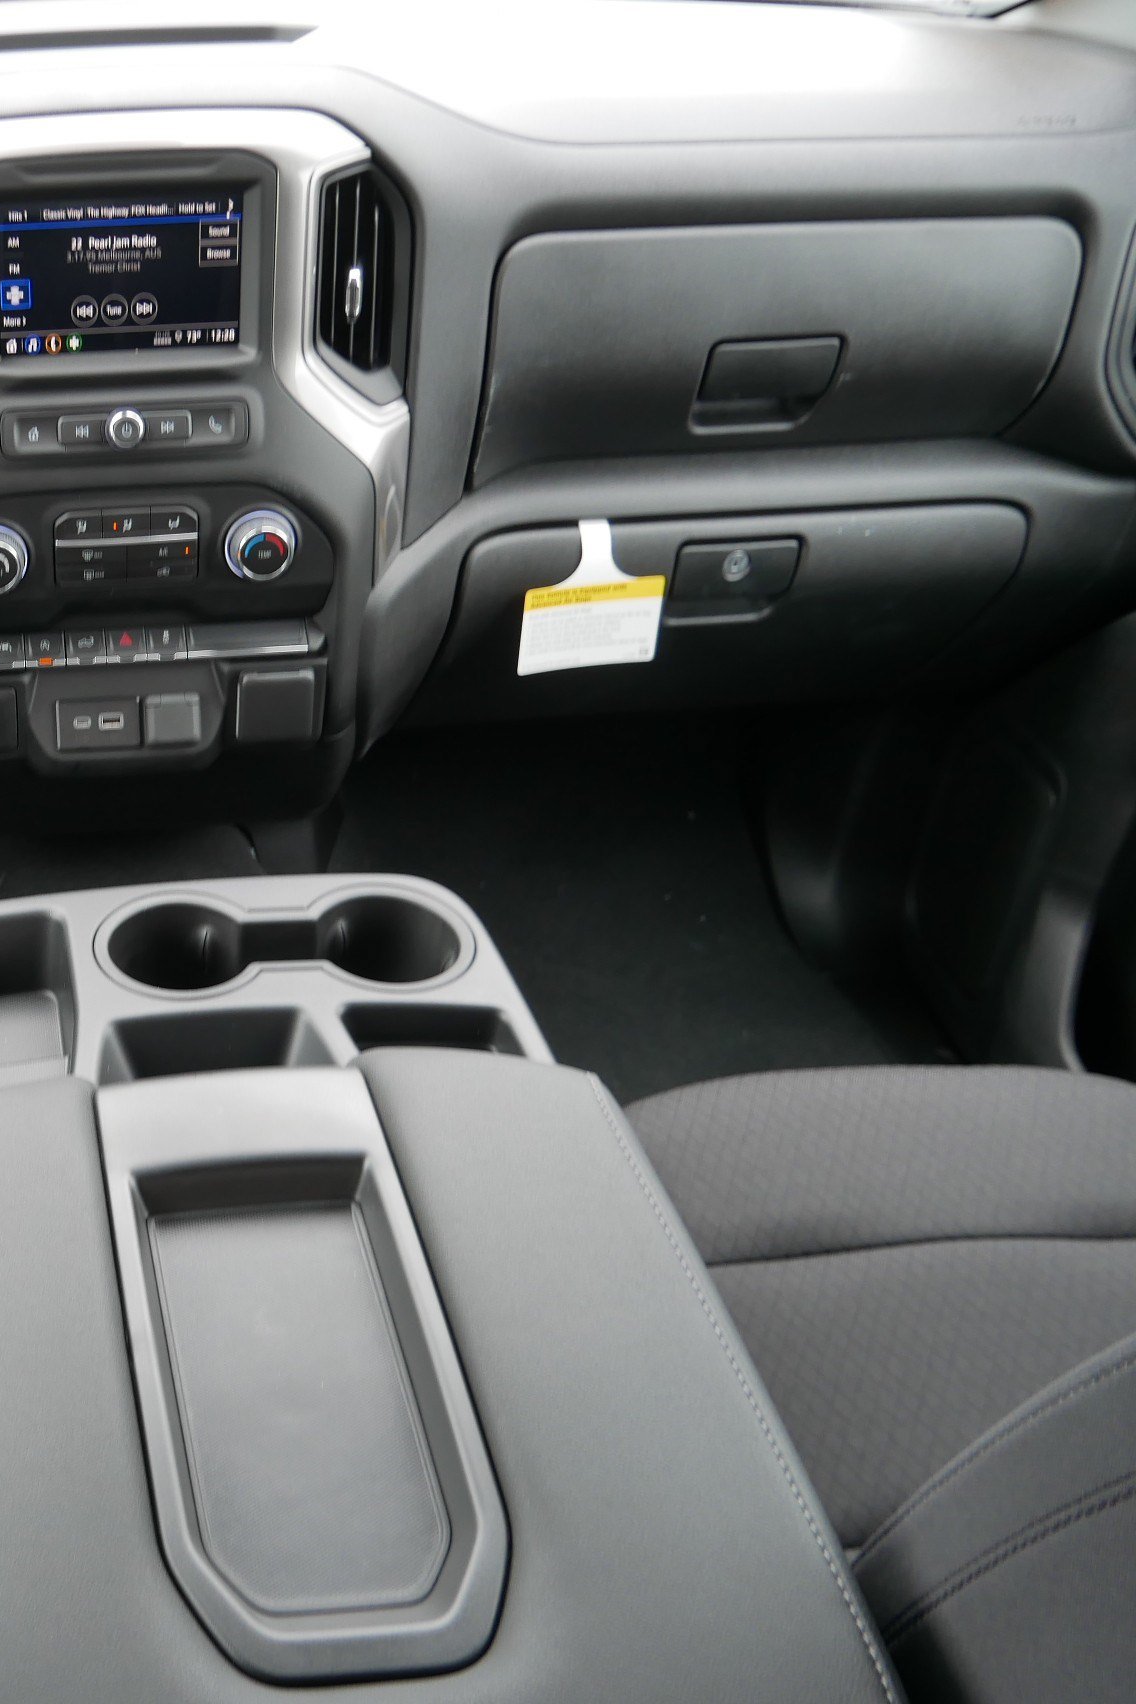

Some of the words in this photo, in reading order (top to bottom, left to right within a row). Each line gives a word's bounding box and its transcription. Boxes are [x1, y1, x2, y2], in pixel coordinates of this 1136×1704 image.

[43, 208, 65, 221] Classic
[67, 206, 83, 221] Vinyl
[87, 206, 99, 219] The
[100, 205, 129, 220] Highway
[131, 204, 145, 217] FOX
[178, 201, 195, 215] Hold
[196, 202, 204, 214] to
[205, 200, 216, 214] Set
[7, 236, 20, 249] AM
[88, 234, 111, 250] Pearl
[112, 234, 130, 252] Jam
[131, 233, 156, 249] Radio
[206, 247, 231, 260] Browse
[8, 262, 20, 275] FM
[3, 315, 21, 328] More
